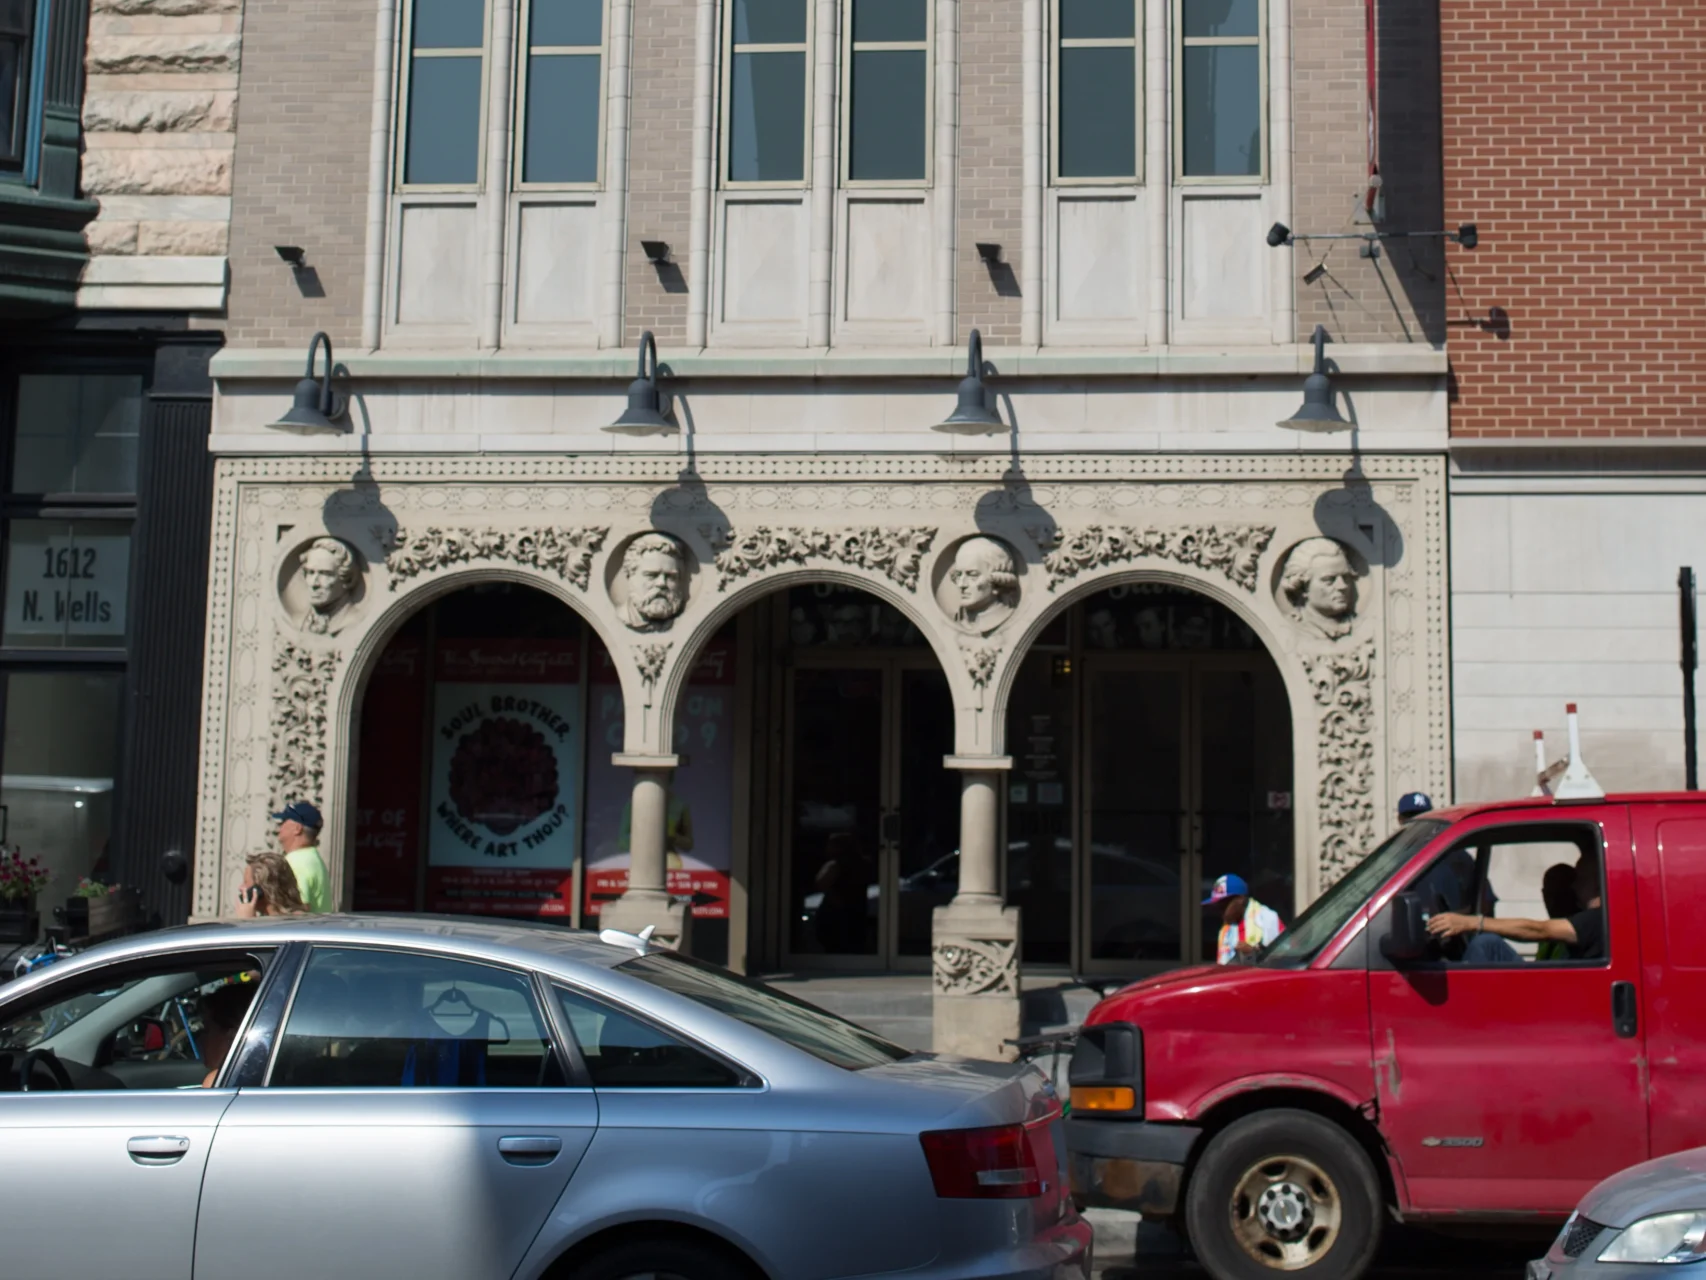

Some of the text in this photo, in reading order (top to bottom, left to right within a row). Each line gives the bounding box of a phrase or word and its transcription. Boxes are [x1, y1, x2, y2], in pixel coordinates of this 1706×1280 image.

[43, 547, 96, 578] 1612
[22, 590, 111, 622] N. Wells
[440, 702, 485, 741] SOUL
[699, 722, 718, 749] 9
[381, 808, 406, 828] OF
[436, 802, 570, 858] WHERE ART THOU?
